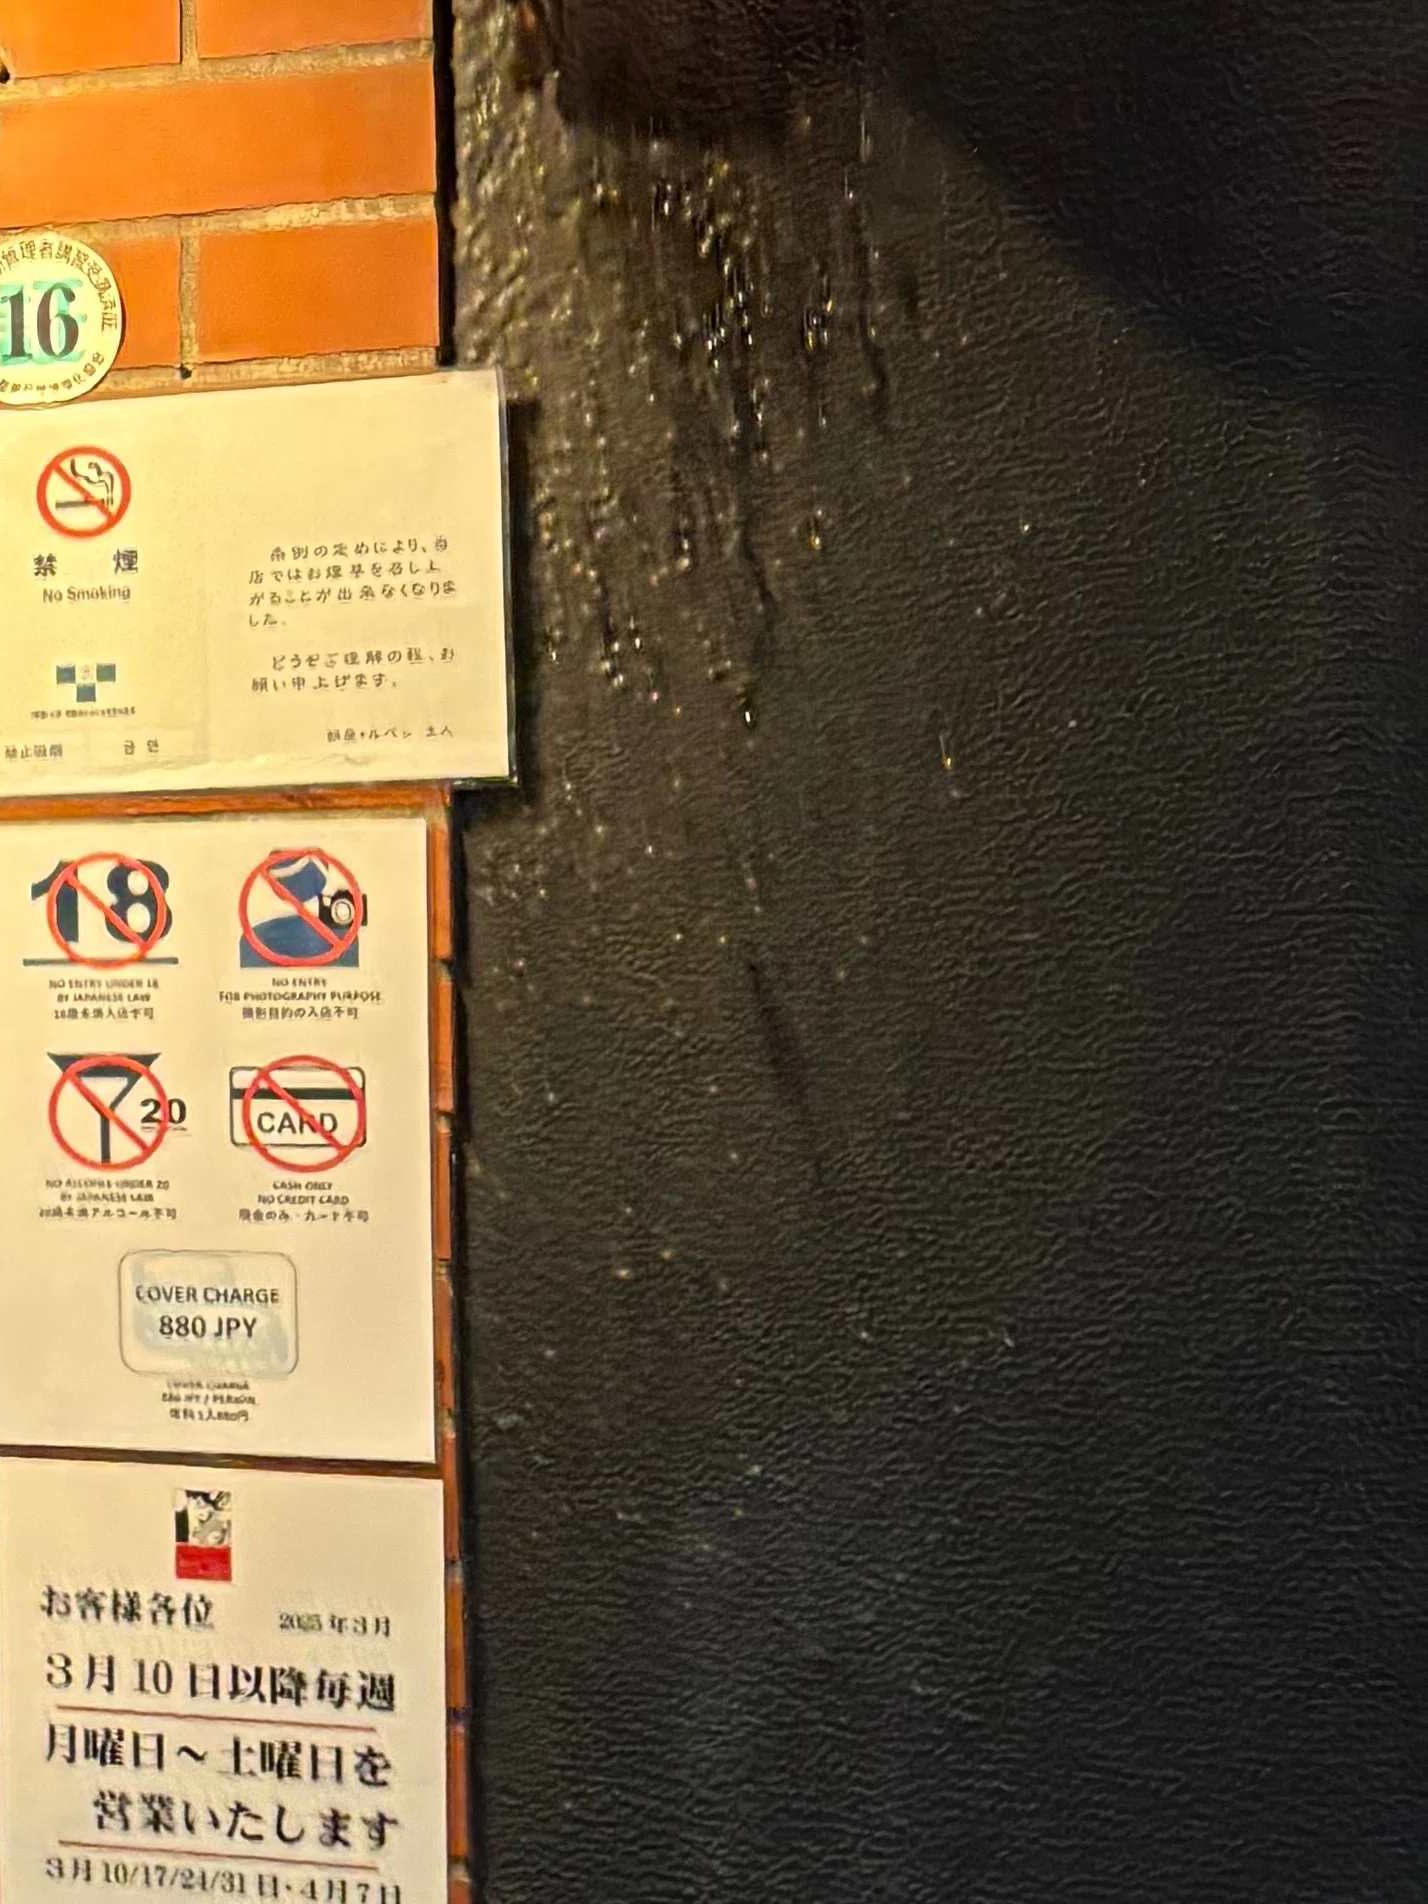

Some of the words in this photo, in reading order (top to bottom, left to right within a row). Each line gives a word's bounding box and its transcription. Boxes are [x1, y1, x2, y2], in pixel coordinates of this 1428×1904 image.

[2, 282, 79, 361] 16
[42, 587, 63, 604] No
[66, 585, 131, 603] Smoking
[31, 859, 173, 943] 18
[49, 979, 65, 989] NO
[272, 978, 289, 987] NO
[140, 1098, 187, 1125] 20
[257, 1112, 338, 1134] CARD
[135, 1284, 197, 1304] COVER
[203, 1287, 279, 1304] CHARGE
[159, 1315, 206, 1339] 880
[214, 1316, 257, 1338] JPY
[41, 1585, 214, 1630] お客様各位
[93, 1790, 398, 1850] 営業いたします
